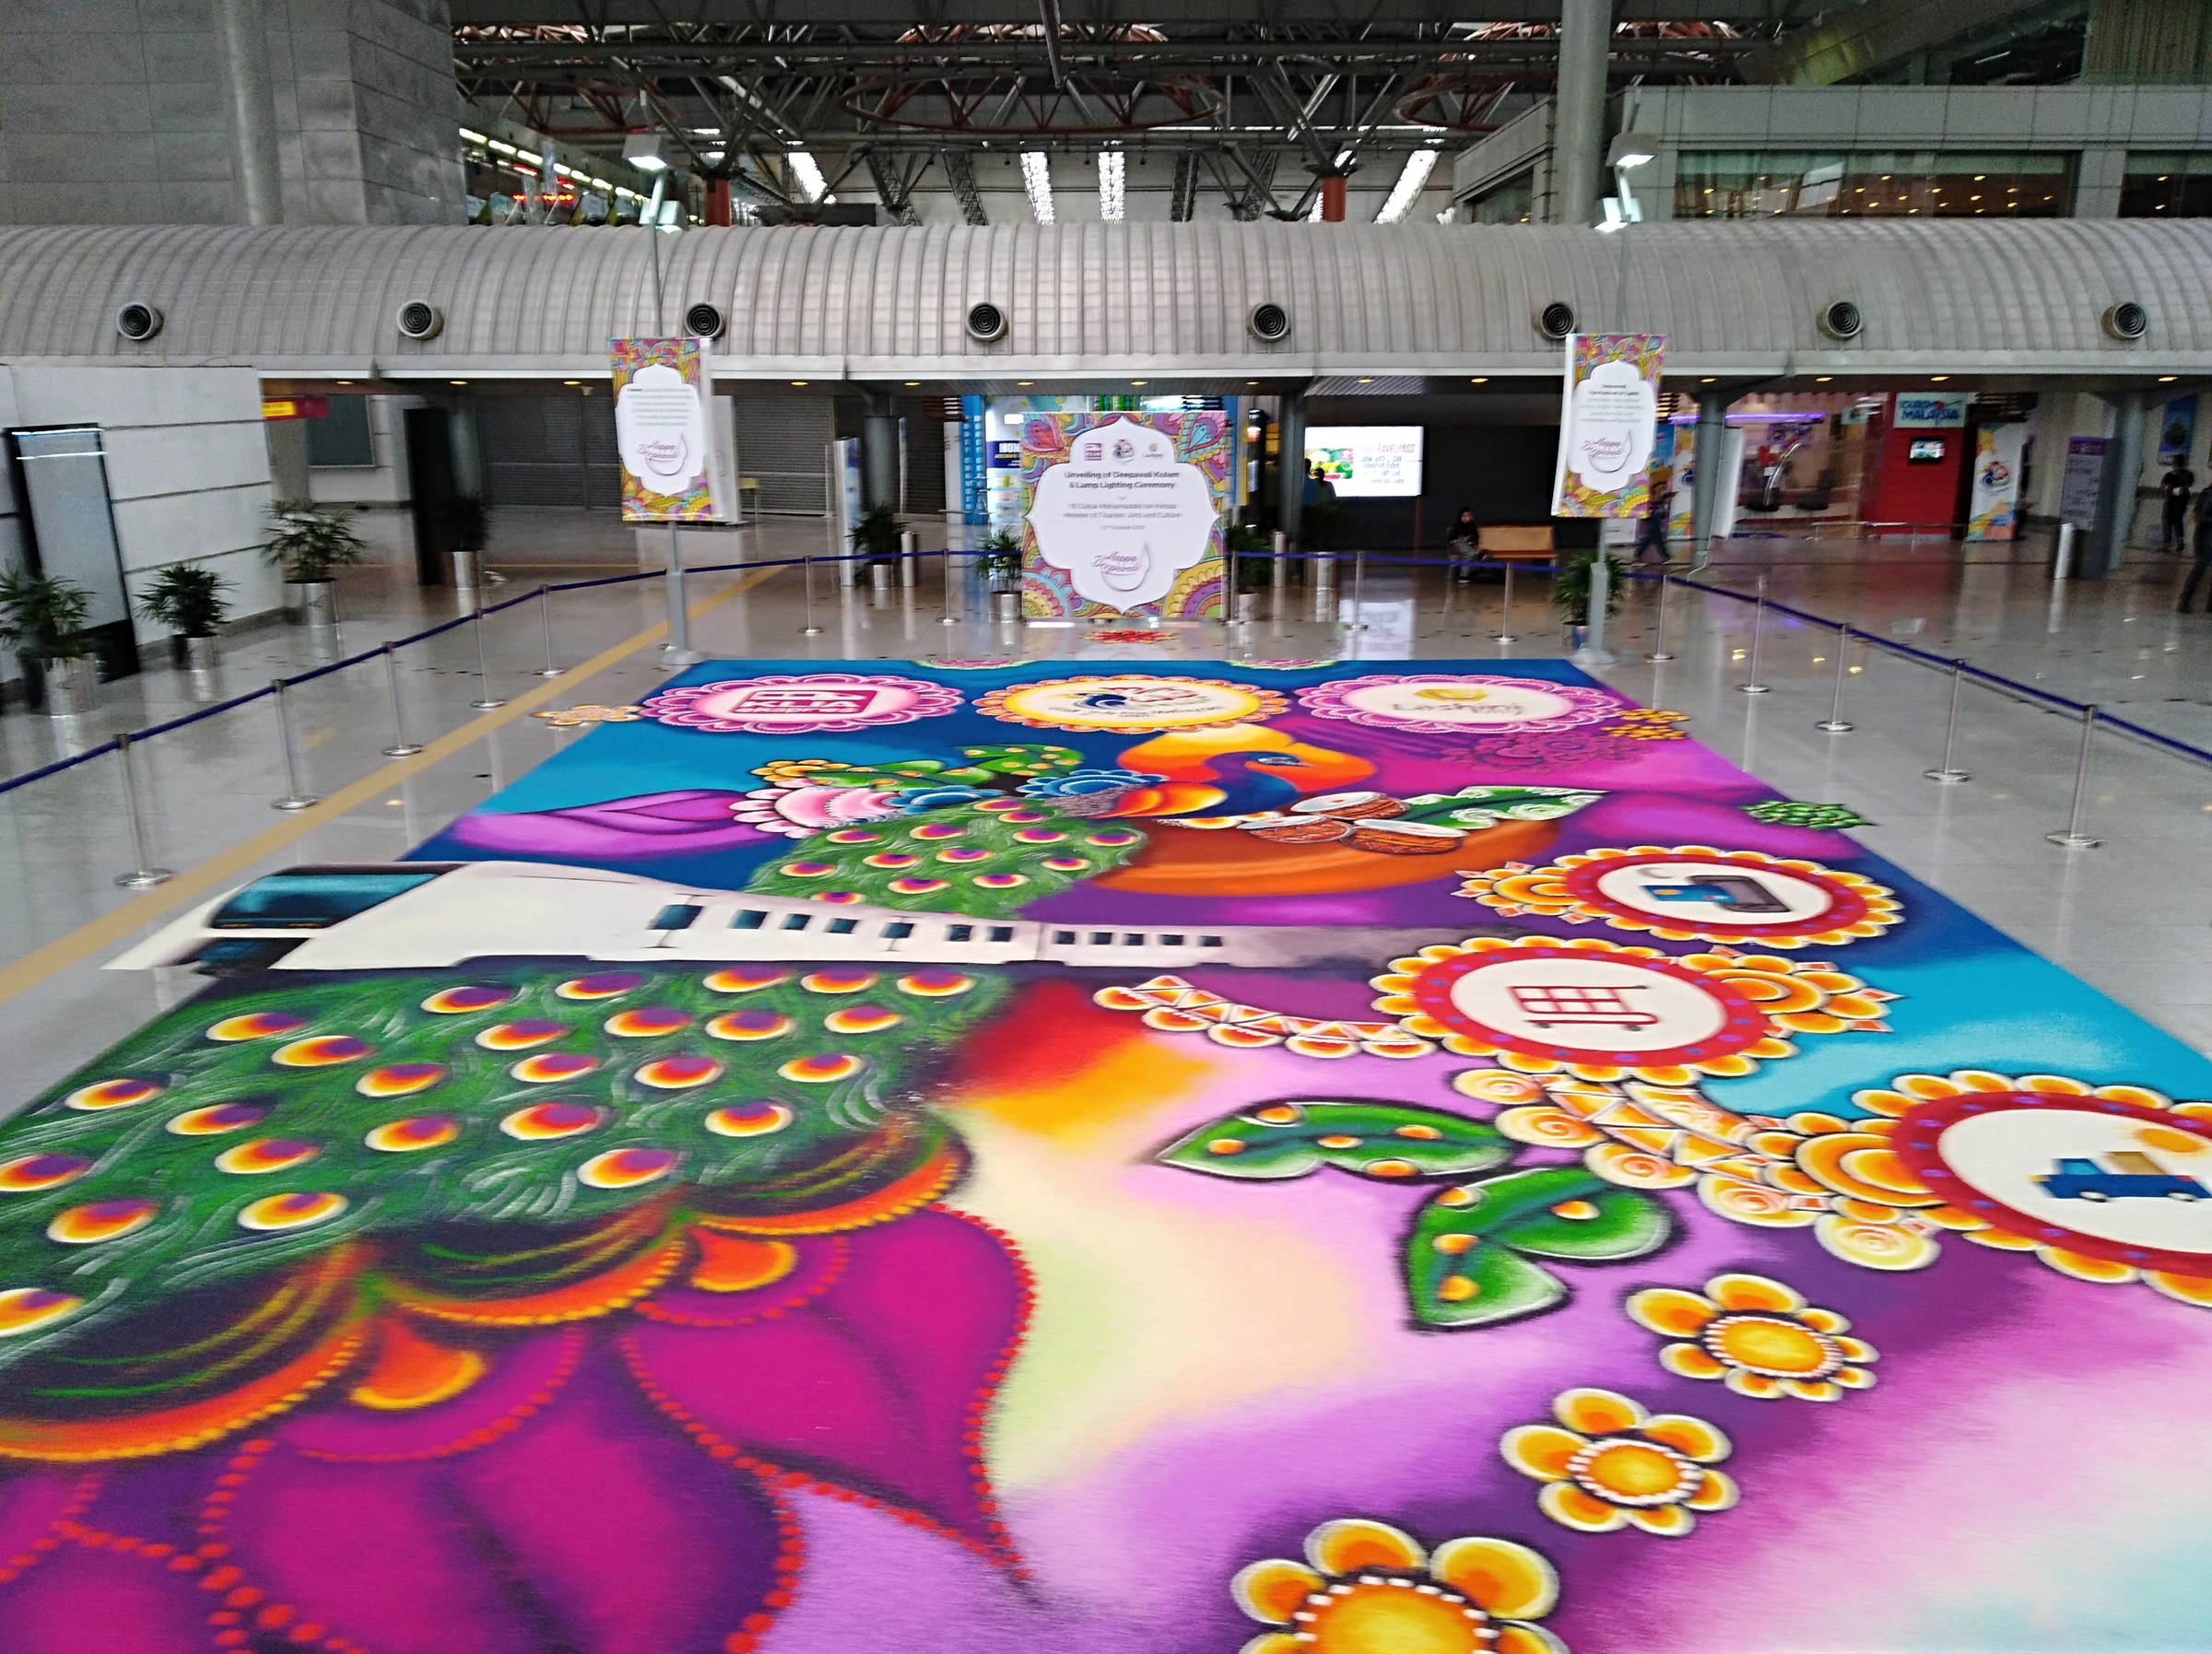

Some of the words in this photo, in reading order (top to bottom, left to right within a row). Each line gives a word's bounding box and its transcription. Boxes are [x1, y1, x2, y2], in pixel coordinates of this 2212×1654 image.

[1901, 409, 1959, 424] MALAYSIA
[1064, 471, 1101, 479] Unveiling
[1112, 471, 1152, 479] Deepavali
[1076, 481, 1099, 489] Lamp
[1100, 481, 1133, 489] Lighting
[1134, 481, 1175, 489] Ceremony
